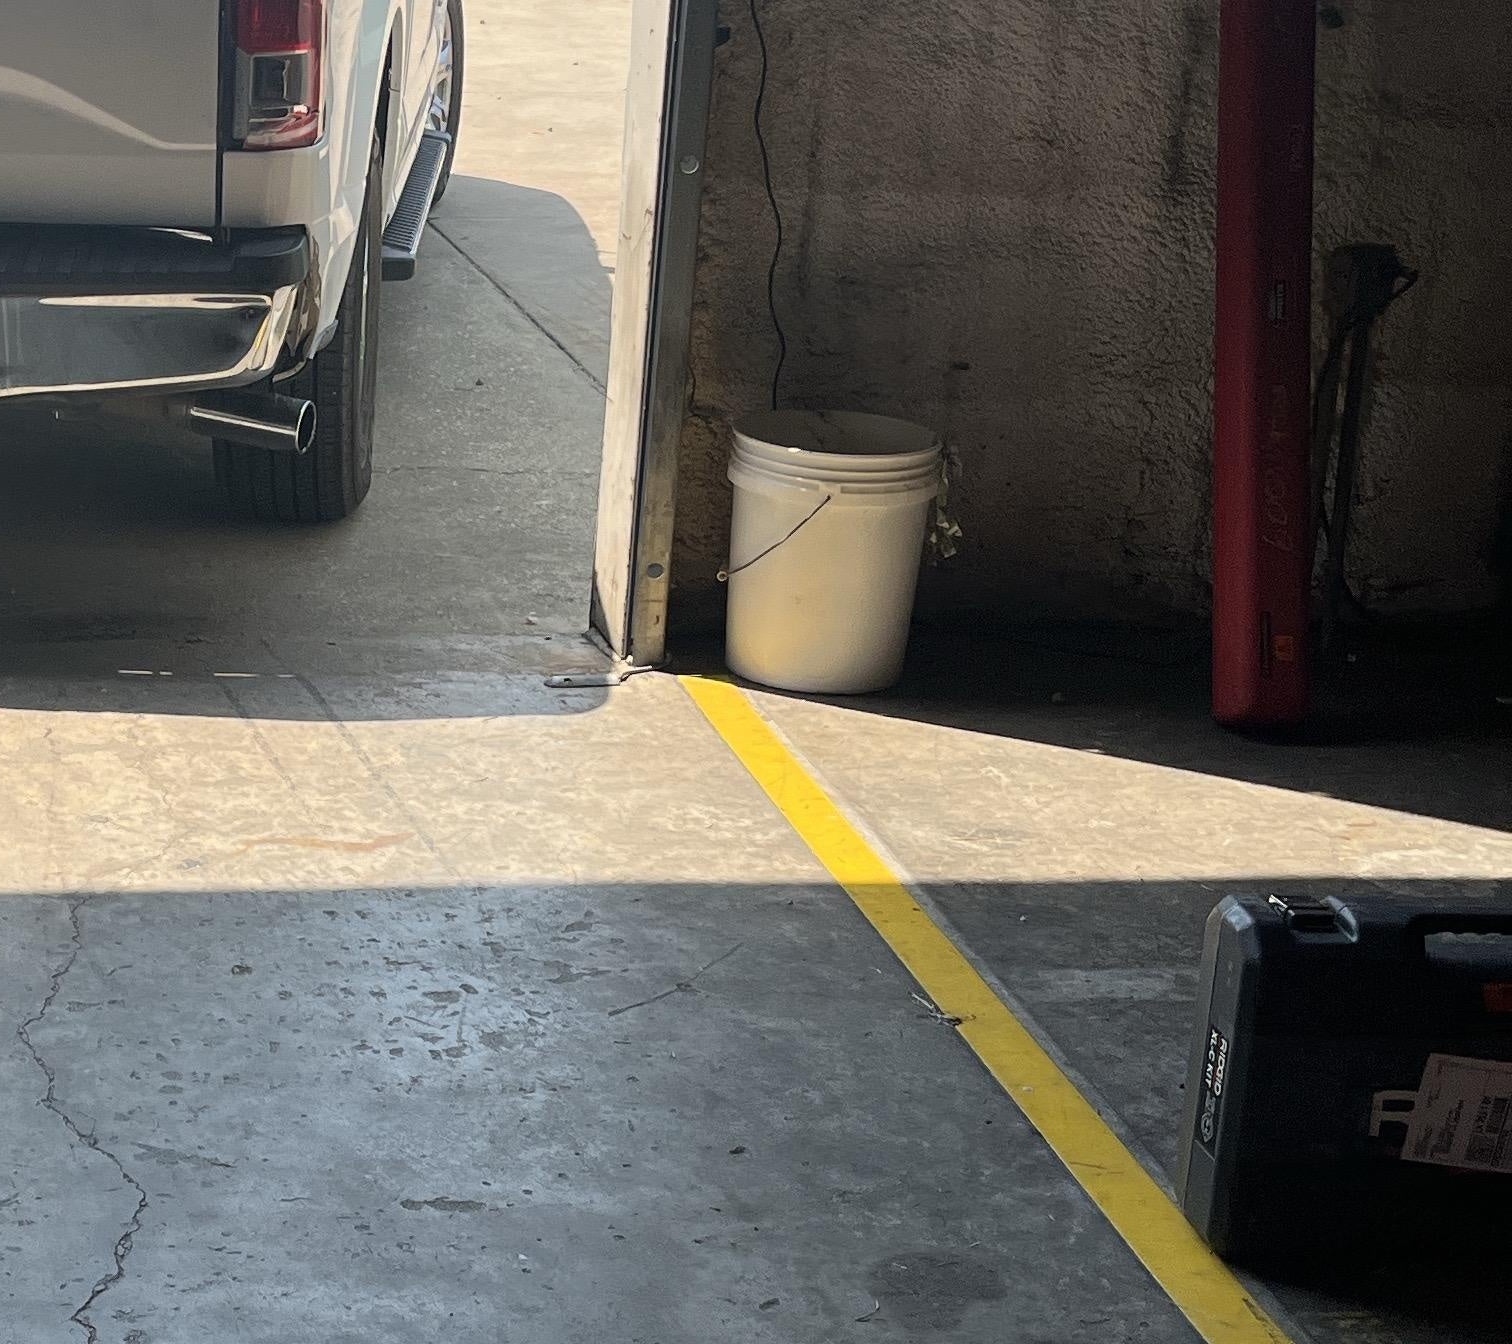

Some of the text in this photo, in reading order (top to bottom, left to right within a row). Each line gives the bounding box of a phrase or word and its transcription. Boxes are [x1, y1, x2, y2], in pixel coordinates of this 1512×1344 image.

[1208, 1030, 1219, 1062] XL-C
[1205, 1063, 1214, 1089] KIT
[1214, 1038, 1228, 1097] RIDGID
